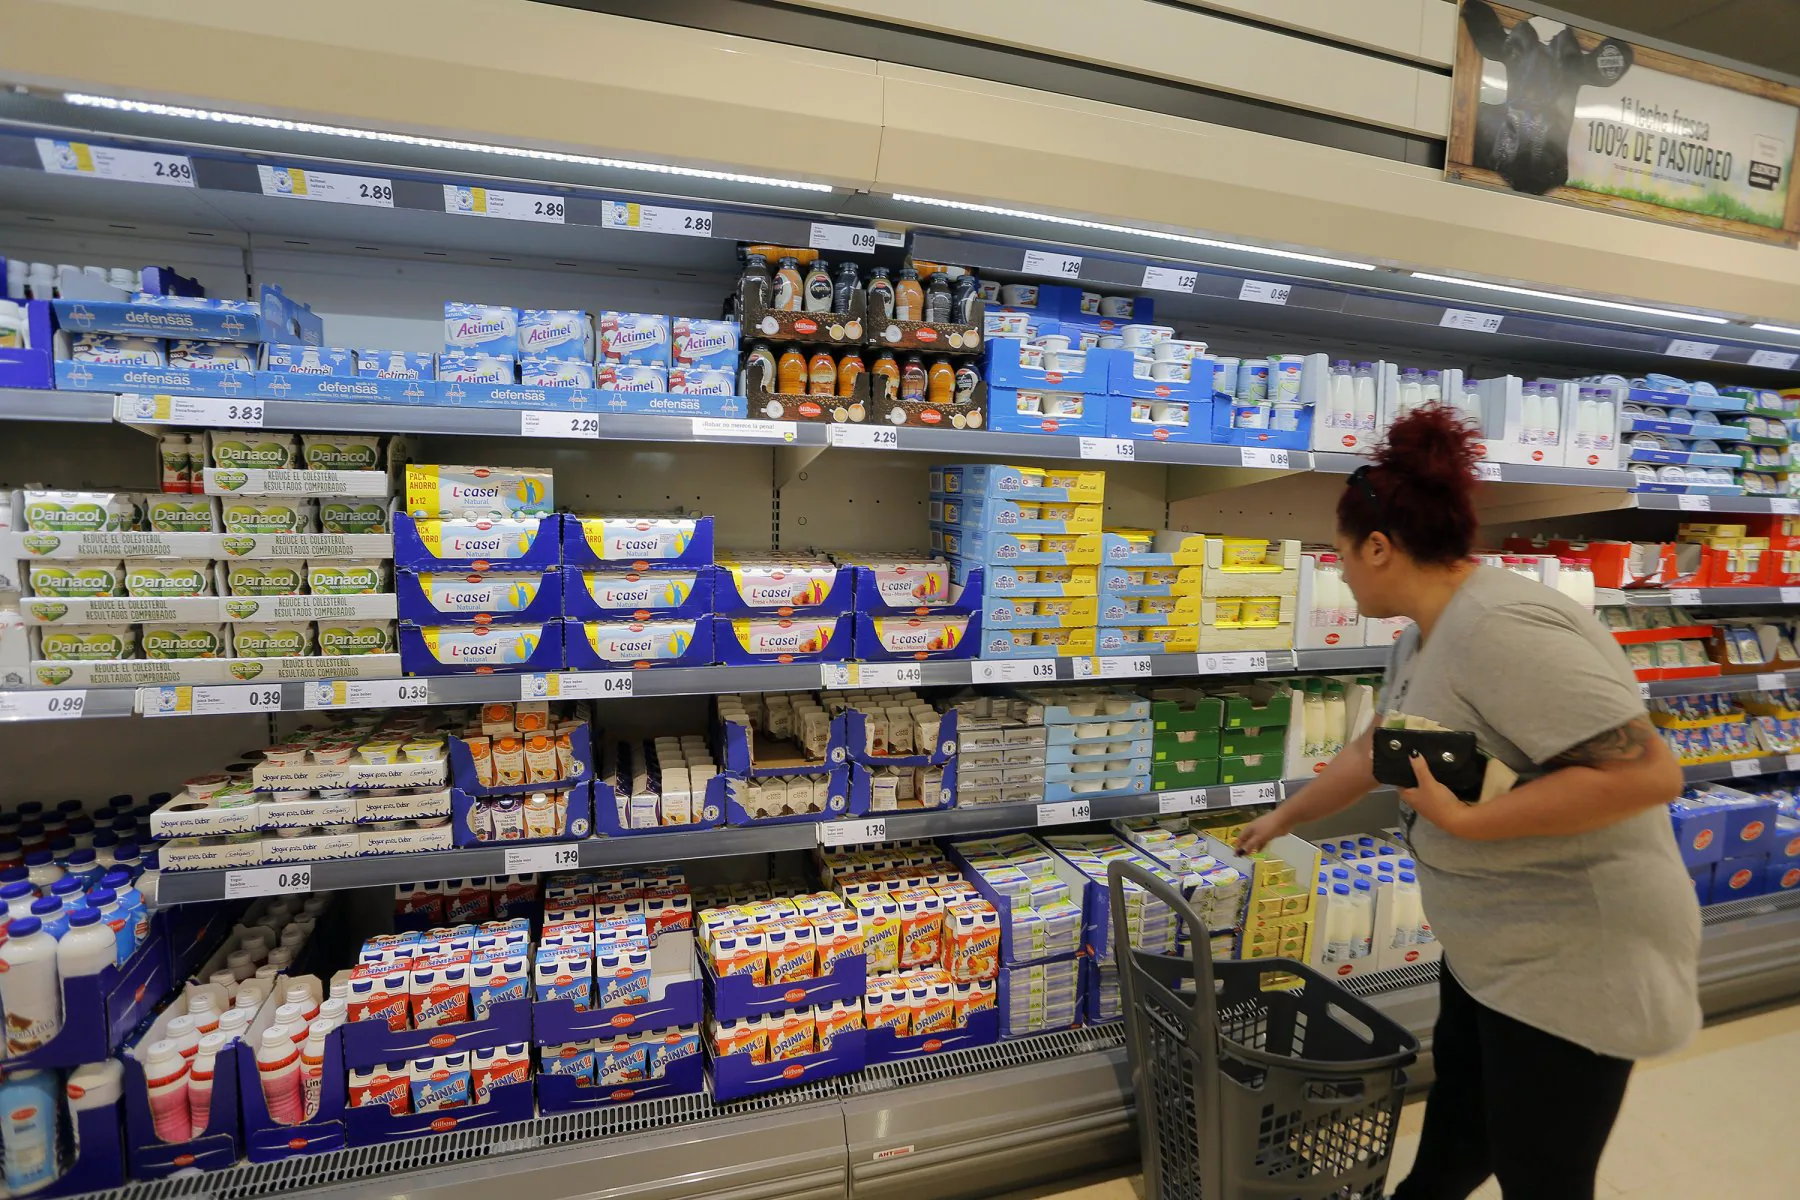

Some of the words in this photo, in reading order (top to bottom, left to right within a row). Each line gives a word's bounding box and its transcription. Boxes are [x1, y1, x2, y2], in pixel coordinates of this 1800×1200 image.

[1635, 100, 1668, 132] leche
[1673, 109, 1709, 141] fresca
[1588, 120, 1628, 159] 100%
[1634, 132, 1654, 164] DE
[1657, 137, 1732, 181] PASTOREO
[154, 162, 191, 179] 2.89
[360, 184, 392, 200] 2.89
[534, 201, 564, 216] 2.89
[684, 216, 711, 231] 2.89
[852, 234, 876, 247] 0.99
[1062, 260, 1080, 273] 1.29
[1178, 276, 1196, 288] 1.25
[1271, 288, 1289, 300] 0.99
[126, 312, 193, 326] defensas
[457, 320, 504, 338] Actimel
[528, 326, 571, 344] Actimel
[612, 329, 656, 346] Actimel
[684, 336, 726, 352] Actimel
[124, 372, 190, 386] defensas
[318, 381, 378, 394] defensas
[490, 389, 546, 400] defensas
[650, 398, 700, 410] defensas
[228, 406, 262, 420] 3.83
[572, 419, 598, 432] 2.29
[874, 431, 896, 443] 2.29
[219, 447, 285, 462] Danacol
[310, 450, 372, 462] Danacol
[1116, 444, 1134, 456] 1.53
[1270, 454, 1288, 464] 0.89
[215, 472, 248, 482] Danacol
[268, 471, 291, 480] REDUCE
[293, 472, 300, 480] EL
[303, 472, 338, 482] COLESTEROL
[264, 482, 302, 491] RESULTADOS
[304, 482, 346, 492] COMPROBADOS
[453, 486, 498, 498] L-casei
[32, 508, 104, 522] Danacol
[154, 508, 210, 522] Danaco
[229, 512, 288, 524] Danacol
[324, 510, 386, 522] Danacol
[222, 539, 254, 548] Danacol
[276, 535, 298, 544] REDUCE
[300, 536, 308, 544] EL
[310, 536, 345, 544] COLESTEROL
[455, 538, 500, 550] L-casei
[616, 539, 658, 550] L-casei
[272, 546, 310, 554] RESULTADOS
[312, 546, 354, 555] COMPROBADOS
[38, 575, 110, 588] Danacol
[132, 575, 200, 587] Danacol
[234, 574, 297, 586] Danacol
[314, 572, 373, 586] Danacol
[882, 582, 912, 591] L-casei
[446, 591, 490, 604] L-casei
[606, 590, 648, 602] L-casei
[752, 588, 790, 598] L-casei
[226, 602, 258, 611] Danacol
[278, 598, 300, 607] REDUCE
[304, 598, 309, 606] EL
[312, 598, 347, 606] COLESTEROL
[274, 608, 312, 617] RESULTADOS
[314, 607, 356, 616] COMPROBADOS
[148, 636, 214, 650] Danacol
[240, 636, 302, 649] Danacol
[324, 632, 384, 644] Danacol
[760, 635, 798, 646] L-casei
[892, 634, 926, 645] L-casei
[48, 640, 118, 652] Danacol
[452, 643, 498, 656] L-casei
[610, 640, 652, 652] L-casei
[1134, 662, 1151, 672] 1.89
[1250, 657, 1264, 667] 2.19
[897, 669, 920, 682] 0.49
[1033, 664, 1053, 676] 0.35
[604, 678, 632, 691] 0.49
[250, 691, 280, 706] 0.39
[398, 686, 427, 700] 0.39
[48, 698, 83, 712] 0.99
[1258, 788, 1274, 798] 2.09
[1190, 794, 1206, 805] 1.49
[1072, 806, 1090, 818] 1.49
[866, 824, 885, 836] 1.79
[555, 850, 578, 864] 1.79
[278, 872, 310, 888] 0.89
